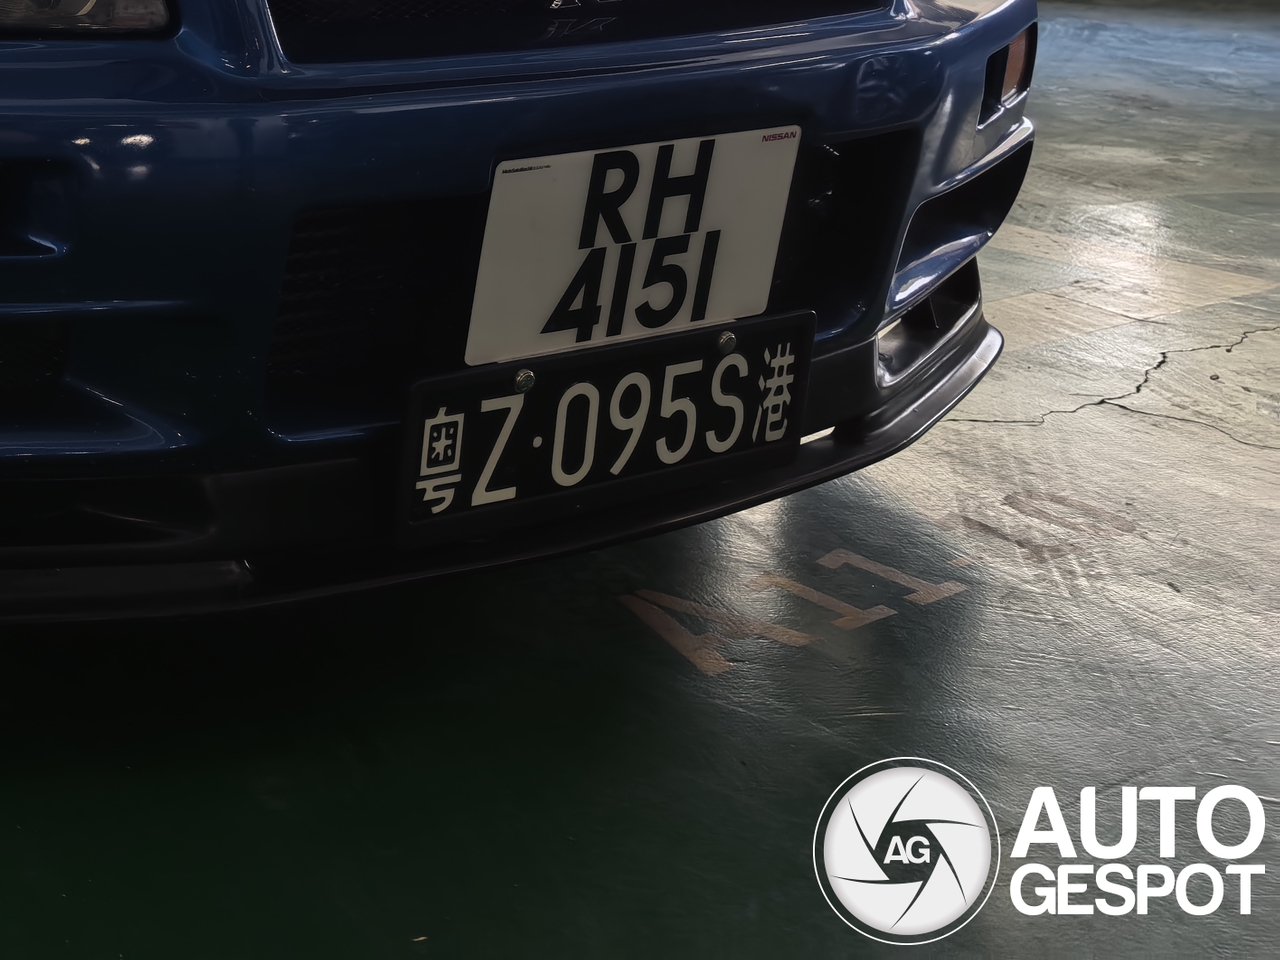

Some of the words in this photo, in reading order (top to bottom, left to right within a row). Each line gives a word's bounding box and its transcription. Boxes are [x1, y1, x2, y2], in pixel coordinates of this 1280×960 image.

[761, 130, 798, 143] NISSAN
[578, 139, 716, 250] RH
[539, 230, 722, 343] 4151
